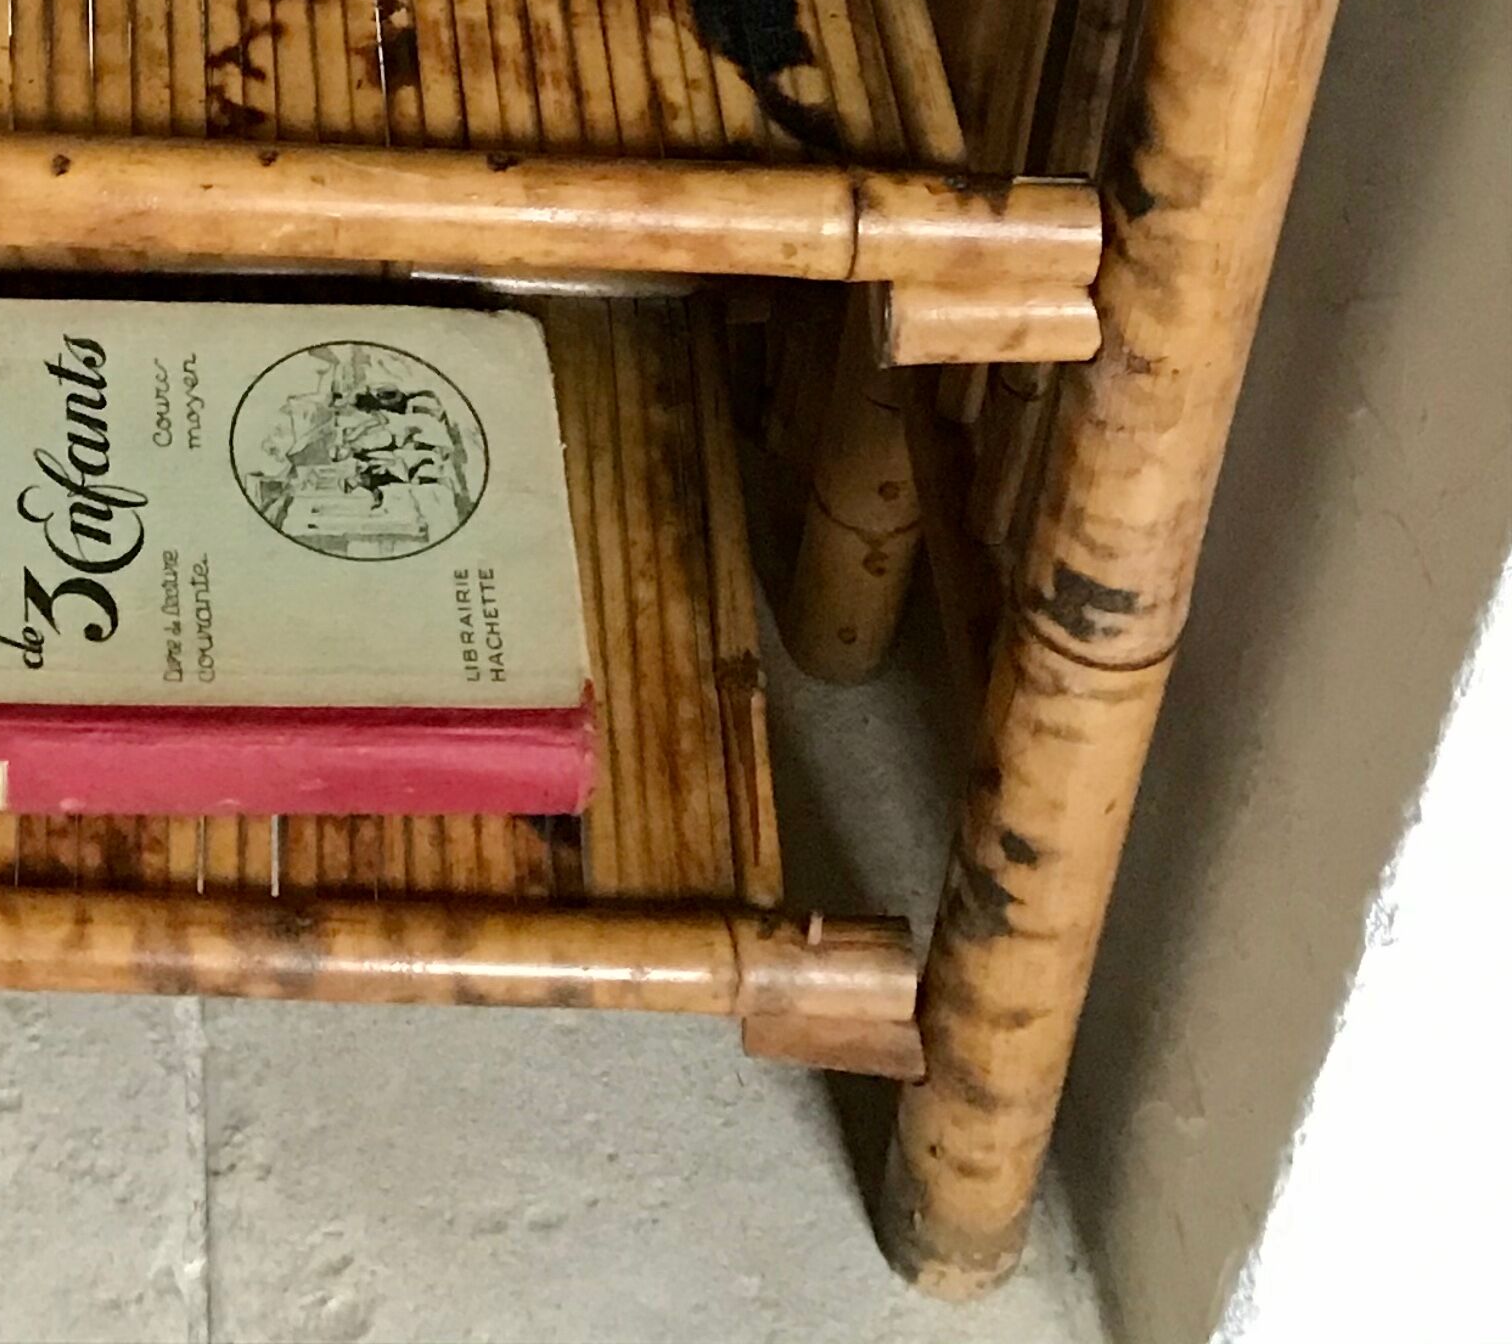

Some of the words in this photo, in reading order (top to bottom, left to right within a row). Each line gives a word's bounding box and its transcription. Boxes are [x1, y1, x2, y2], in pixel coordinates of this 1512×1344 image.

[16, 333, 149, 575] Enfants
[188, 353, 206, 450] moyen
[23, 565, 119, 643] 3
[453, 568, 481, 683] LIBRAIRIE
[477, 567, 507, 683] HACHETTE
